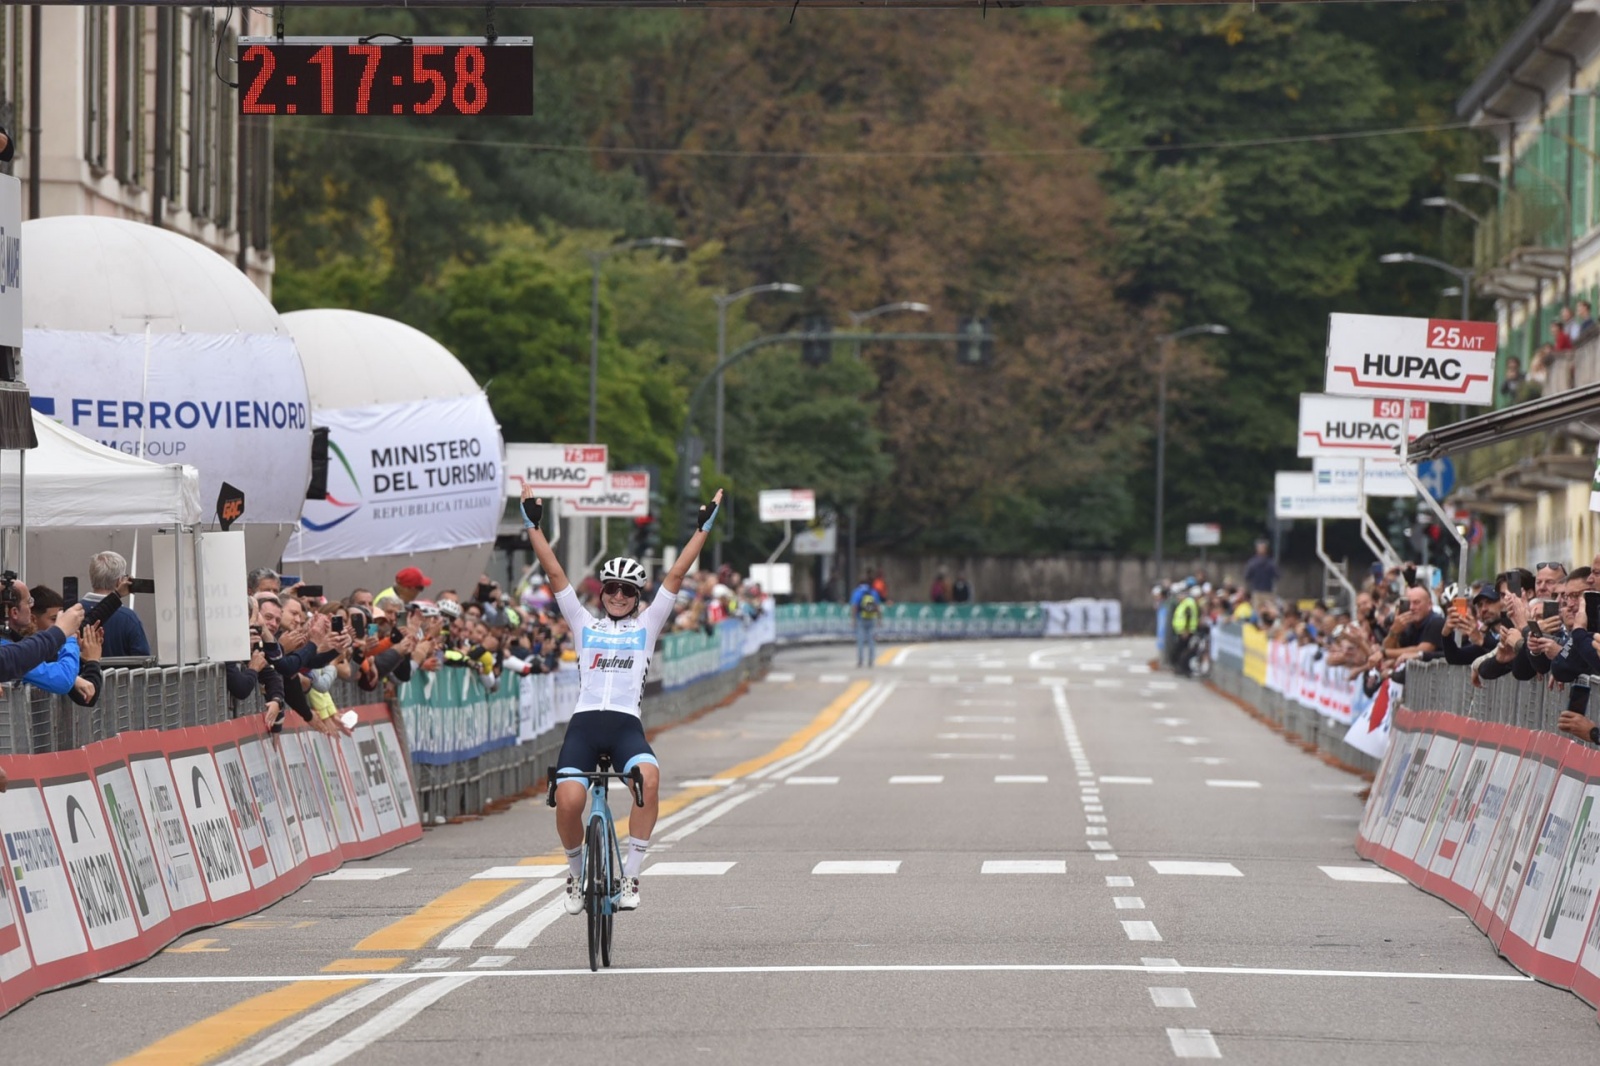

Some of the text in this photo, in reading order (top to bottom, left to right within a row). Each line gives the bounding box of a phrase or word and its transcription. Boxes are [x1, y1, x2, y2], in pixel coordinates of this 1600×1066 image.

[241, 44, 488, 115] 2:17:58
[1431, 326, 1485, 350] 25 MT
[1362, 353, 1462, 381] HUPAC
[71, 398, 306, 430] FERROVIENORD
[1379, 401, 1401, 418] 50
[1325, 420, 1400, 441] HUPAC
[370, 437, 482, 469] MINISTERO
[565, 448, 584, 462] 75
[373, 461, 496, 494] DEL TURISMO
[526, 467, 587, 481] HUPAC
[372, 500, 452, 521] REPUBBLICA
[585, 634, 640, 645] TREK
[588, 652, 634, 670] Segafredo
